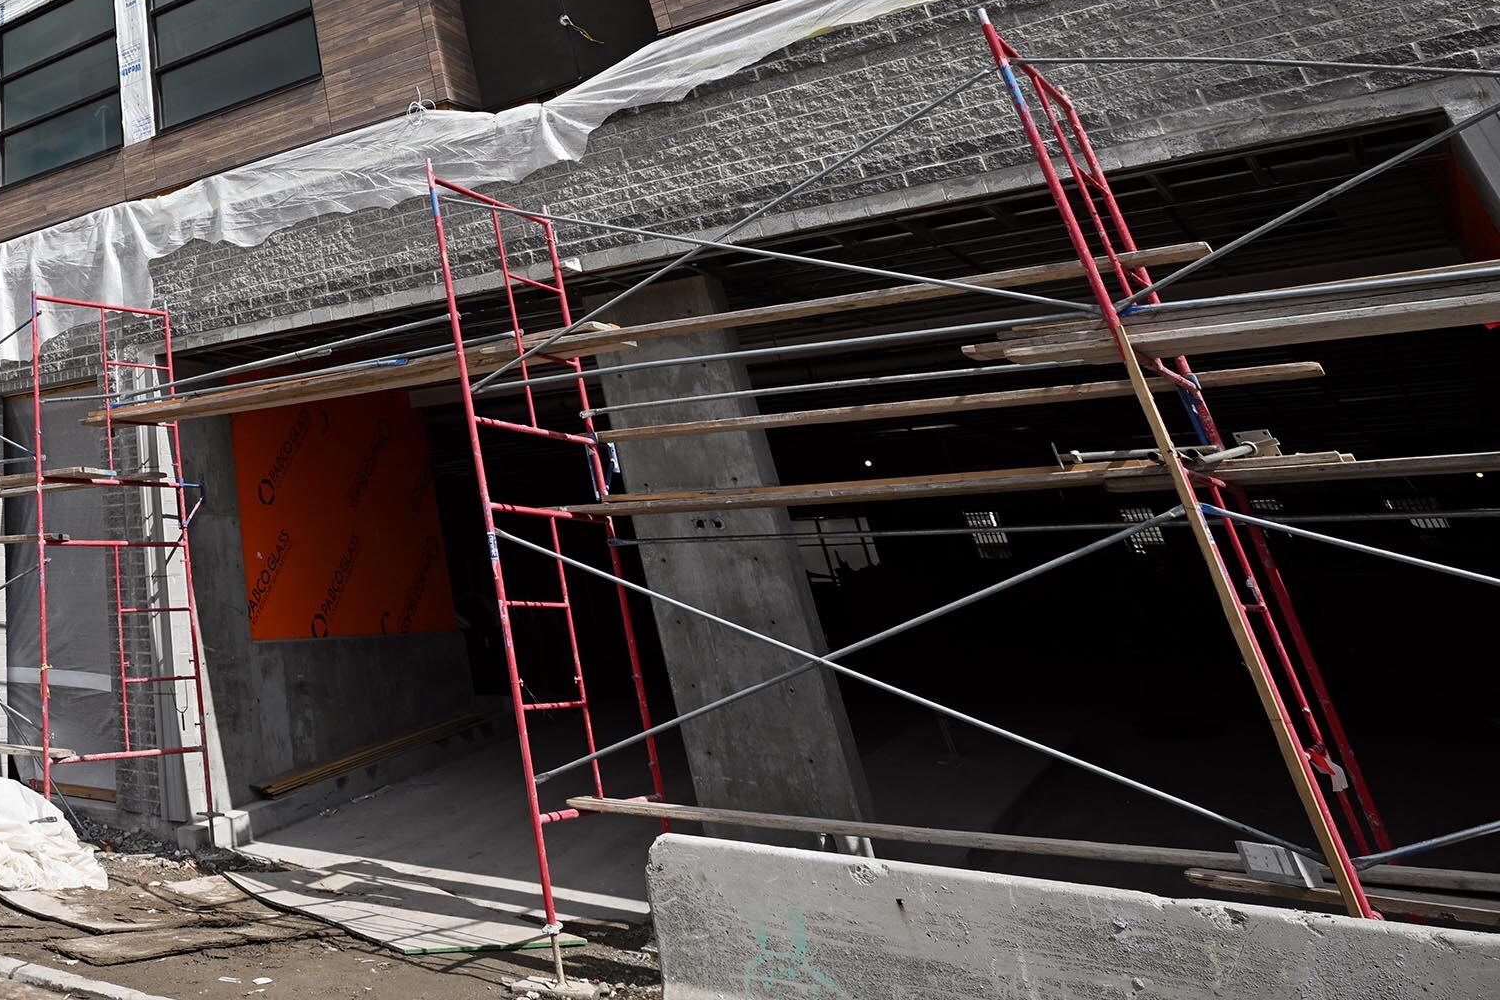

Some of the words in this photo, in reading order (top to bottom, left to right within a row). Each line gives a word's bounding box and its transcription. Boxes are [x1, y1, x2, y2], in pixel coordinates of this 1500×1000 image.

[269, 440, 293, 481] PABCO
[268, 529, 290, 569] GLASS
[342, 532, 360, 571] GLASS
